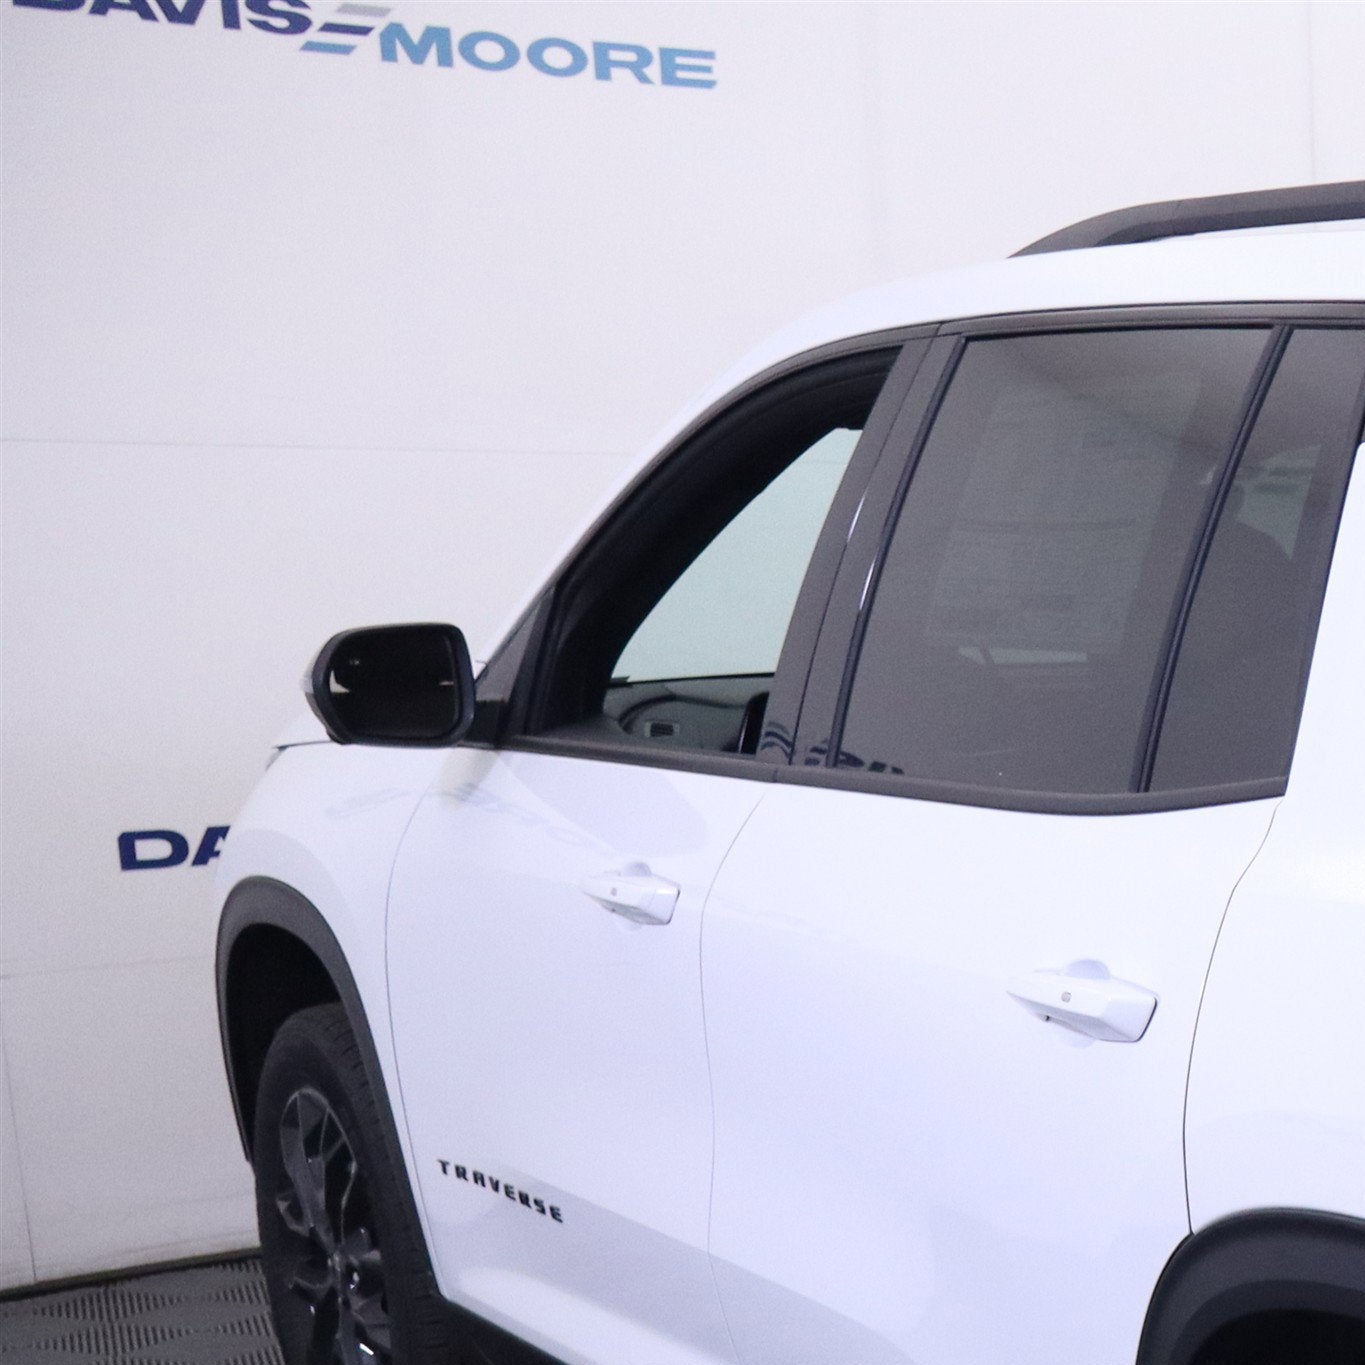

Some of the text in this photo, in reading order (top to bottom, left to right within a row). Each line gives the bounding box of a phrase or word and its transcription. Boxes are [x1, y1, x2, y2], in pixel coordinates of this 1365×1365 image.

[12, 0, 718, 90] VIS MOORE
[437, 1159, 563, 1223] TRAVERSE
